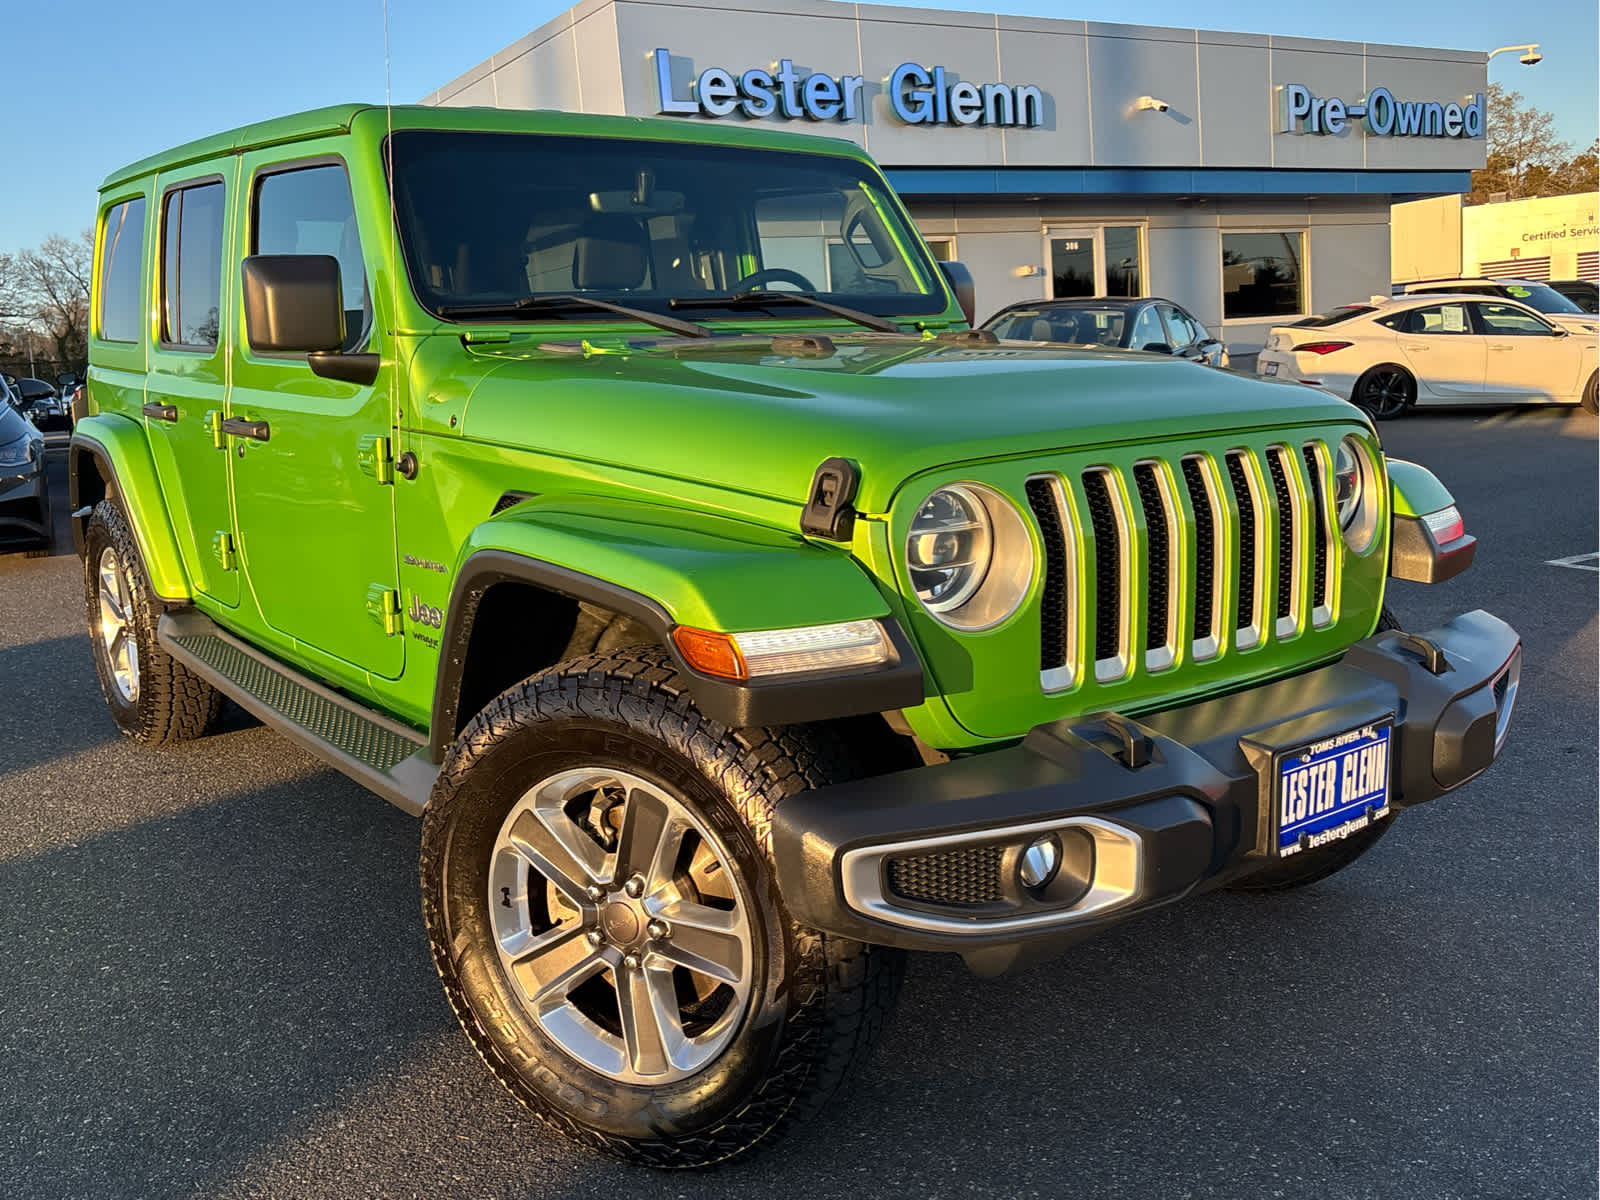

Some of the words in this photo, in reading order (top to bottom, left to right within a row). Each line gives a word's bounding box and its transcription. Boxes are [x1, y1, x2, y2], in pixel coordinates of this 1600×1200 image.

[655, 48, 864, 120] Lester
[889, 62, 1043, 126] Glenn
[1286, 83, 1484, 136] Pre-Owned
[1522, 229, 1567, 242] Certified
[408, 594, 445, 629] Jee
[1310, 739, 1335, 755] TOMS
[1280, 759, 1337, 827] LESTER
[1341, 741, 1387, 804] GLENN
